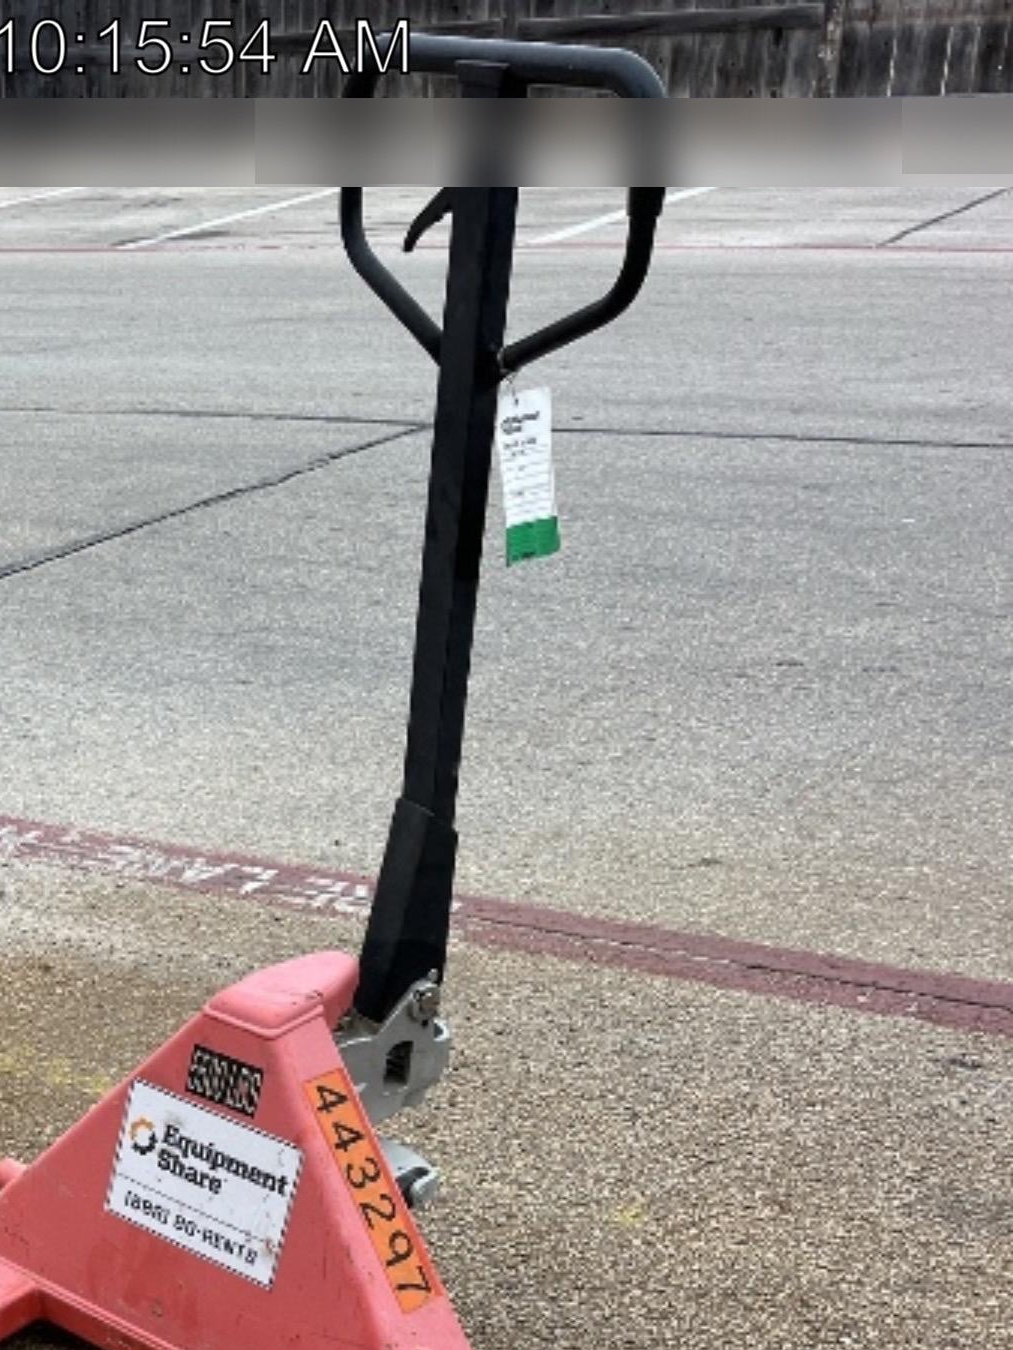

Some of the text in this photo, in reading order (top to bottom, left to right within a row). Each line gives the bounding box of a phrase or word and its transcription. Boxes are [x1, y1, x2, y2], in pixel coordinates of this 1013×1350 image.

[156, 1149, 224, 1195] Share
[161, 1123, 289, 1196] Equipment
[315, 1084, 432, 1294] 443297
